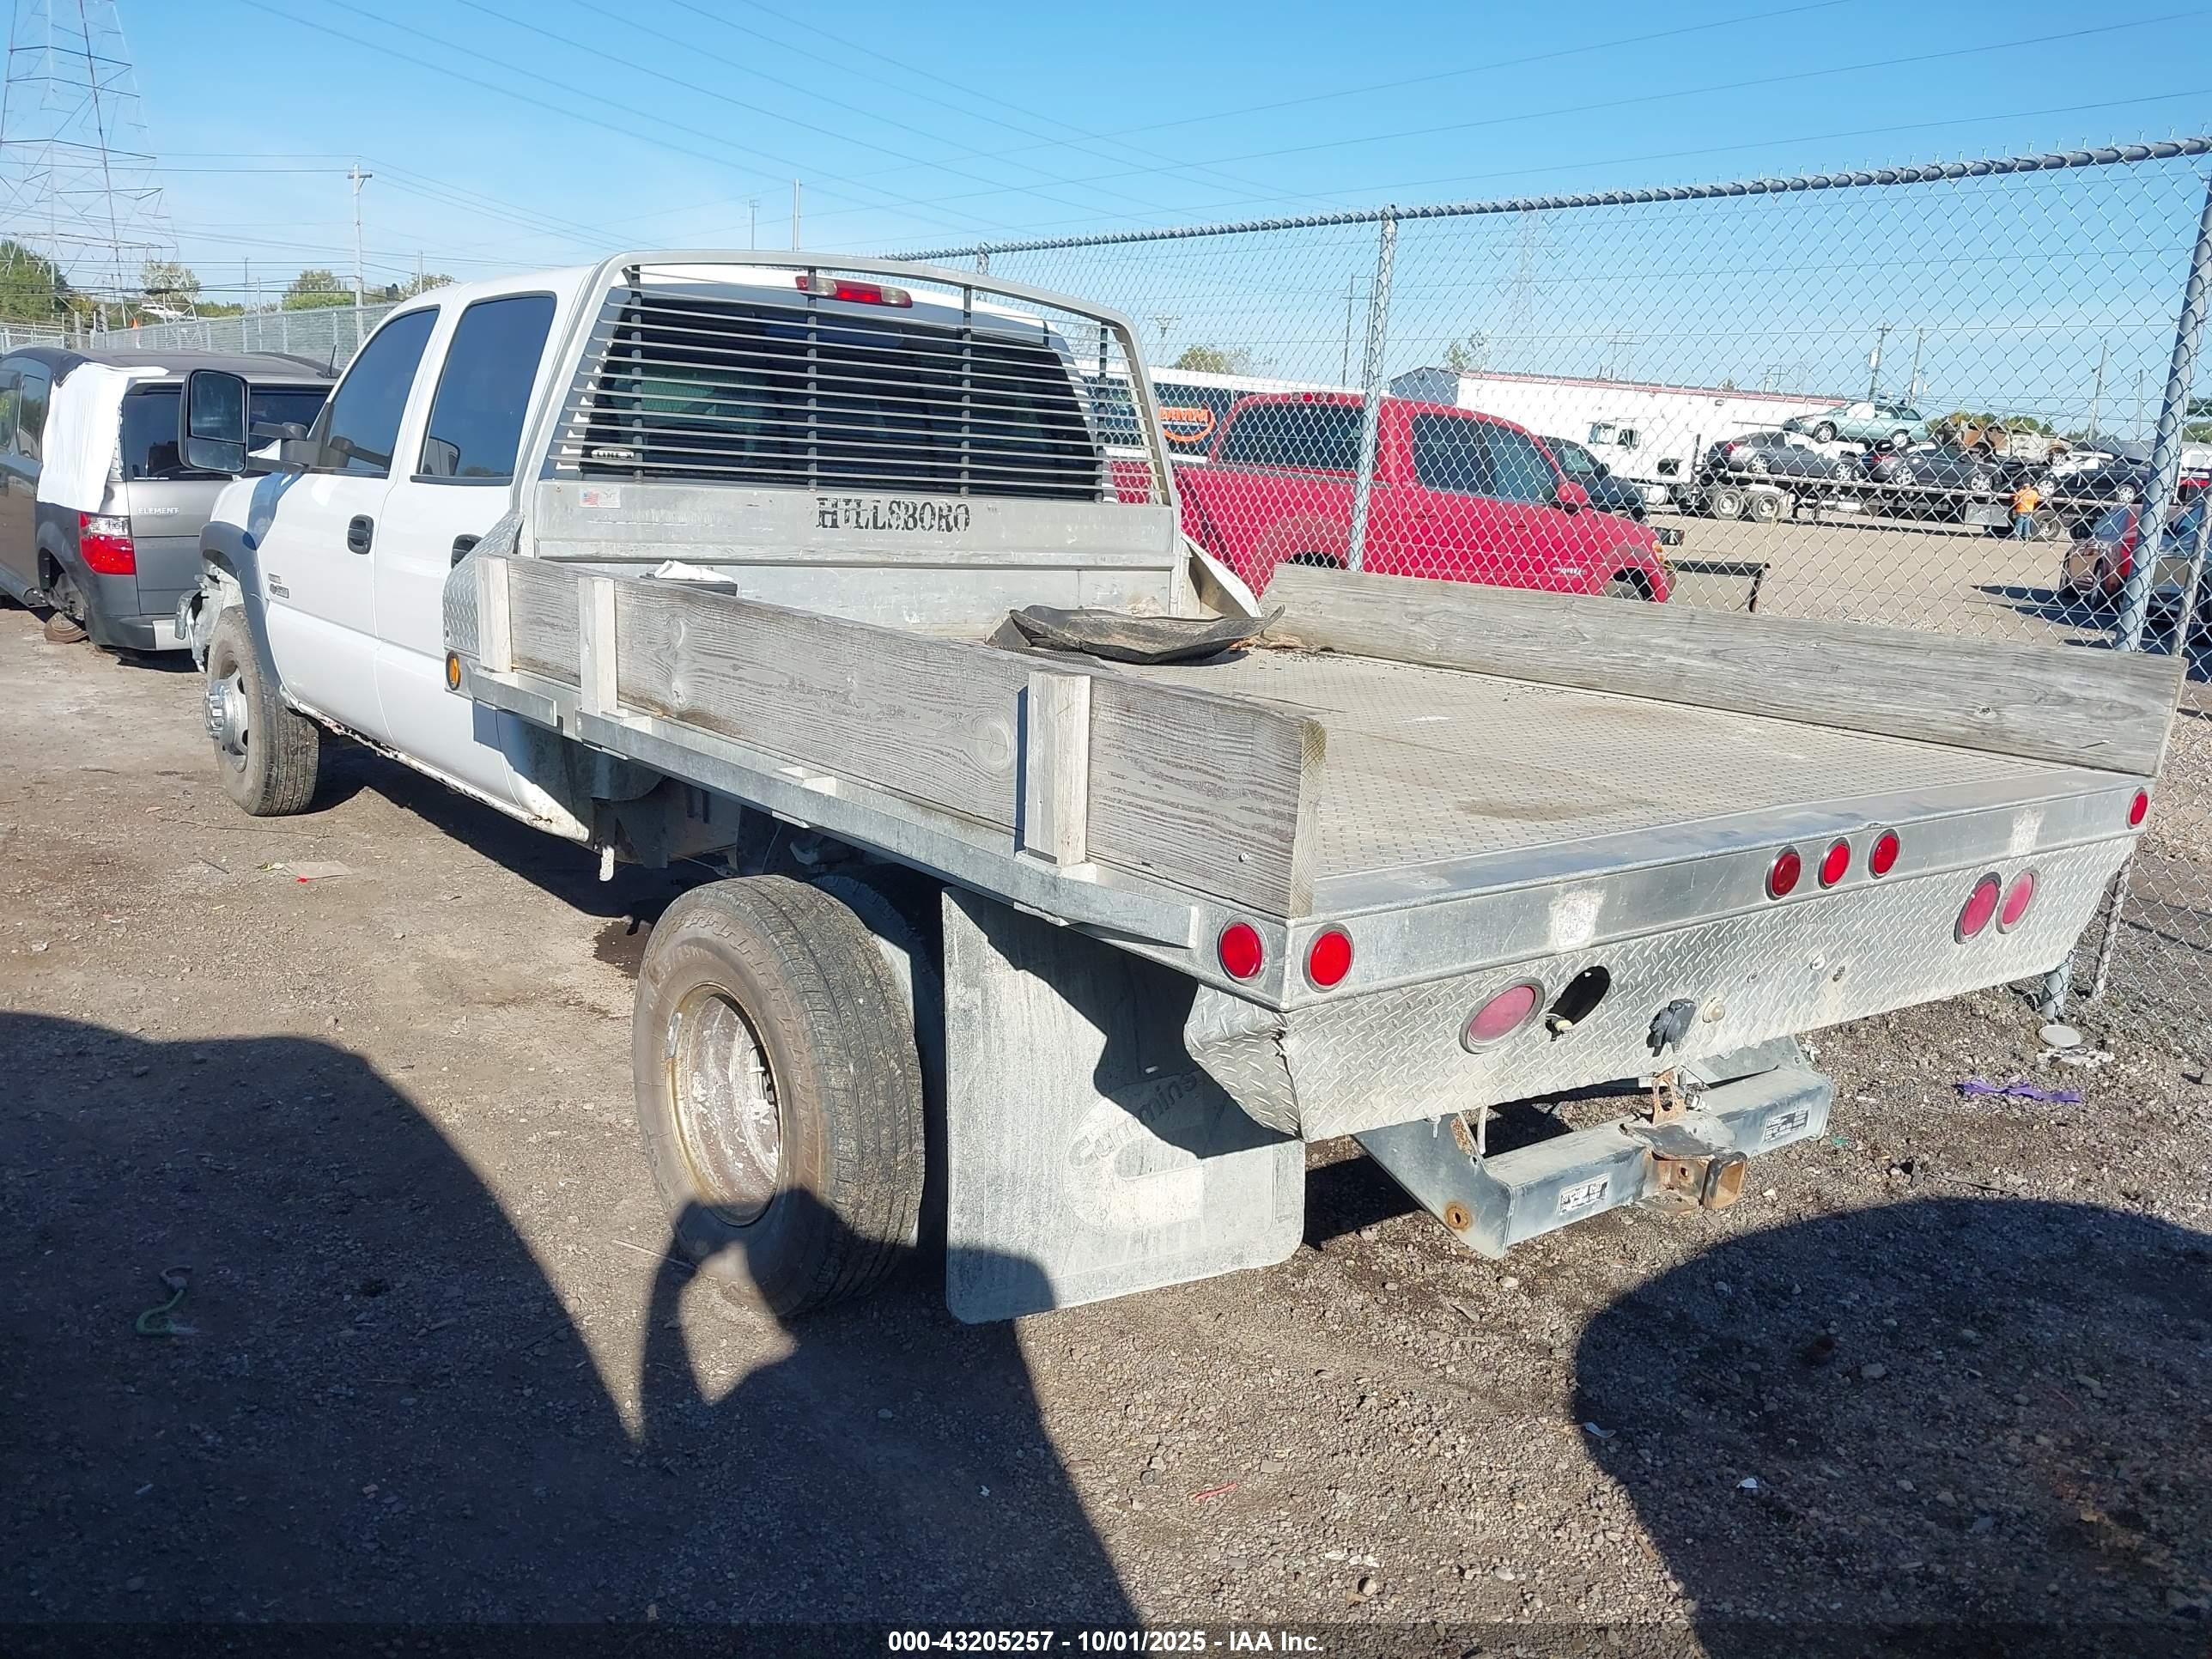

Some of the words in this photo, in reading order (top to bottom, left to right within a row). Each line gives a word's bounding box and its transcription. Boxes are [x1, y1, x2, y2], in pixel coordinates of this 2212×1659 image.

[137, 507, 179, 515] ELEMENT
[816, 497, 970, 533] HILLSBORO
[1070, 1073, 1197, 1168] Cummins
